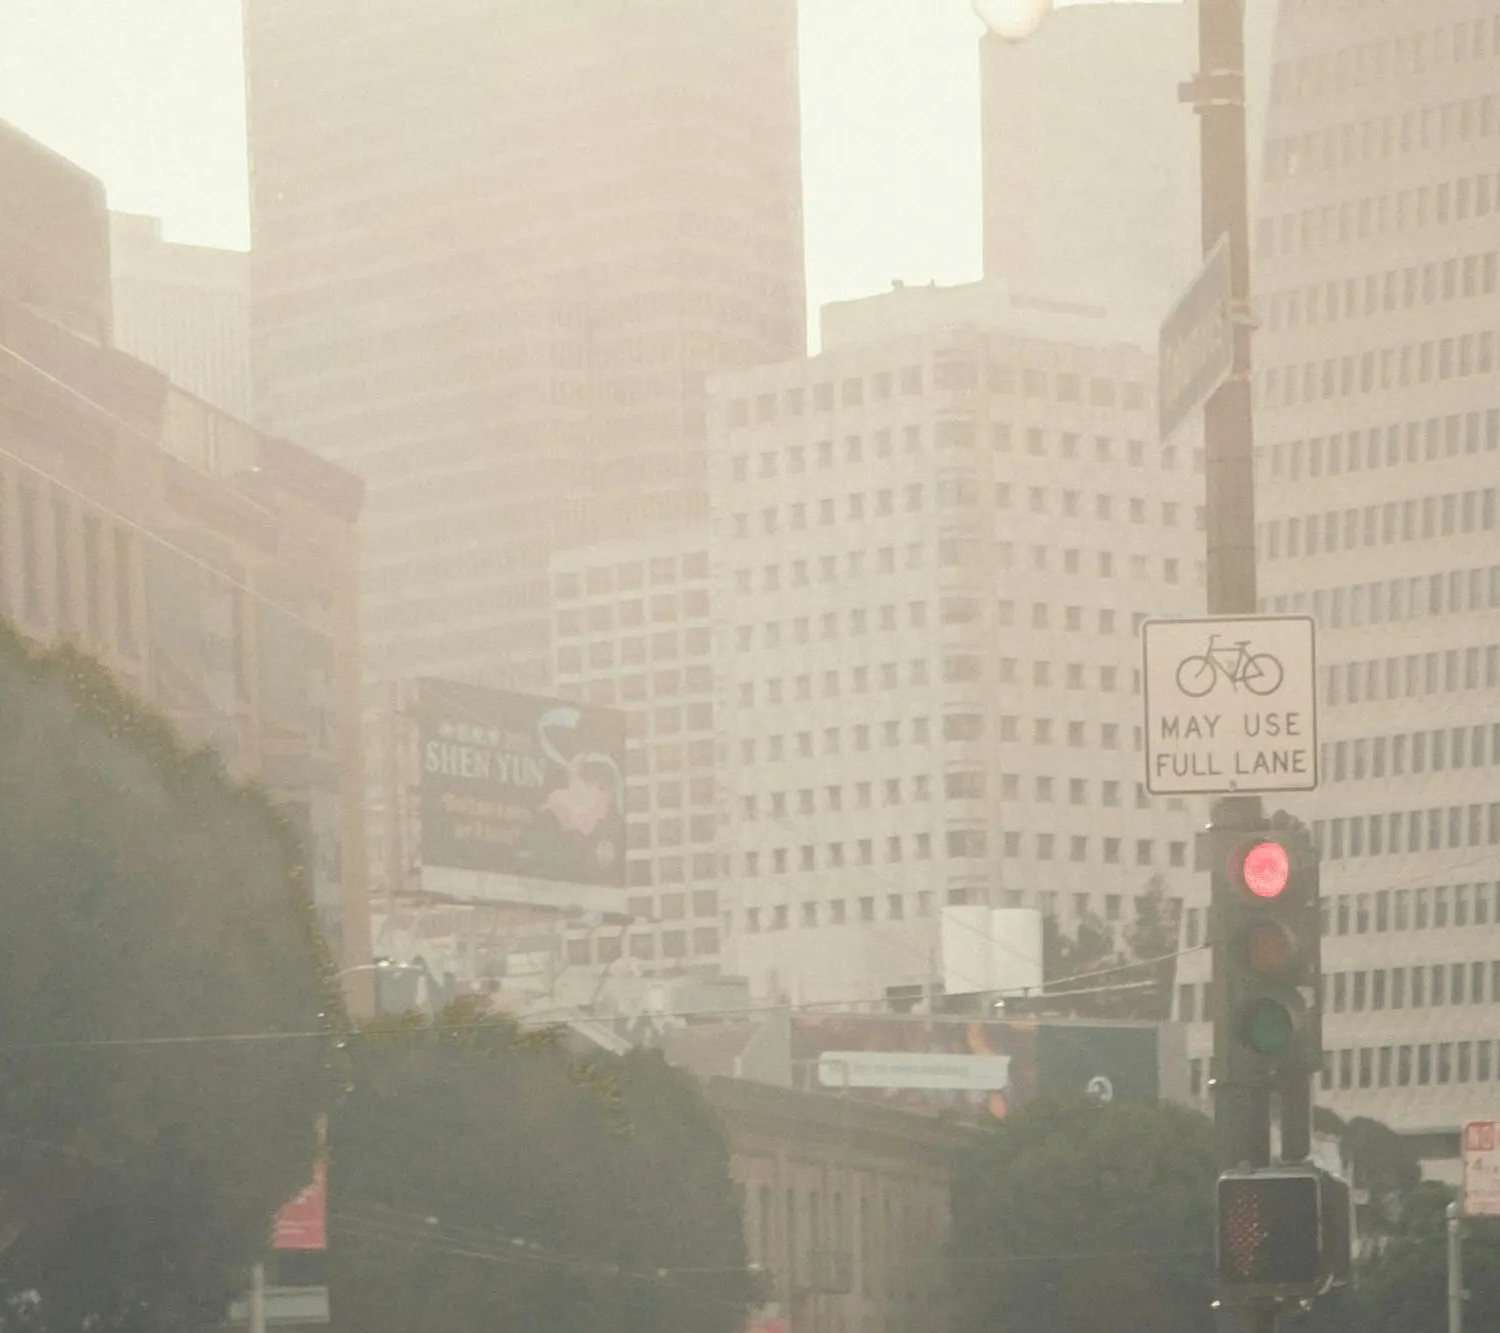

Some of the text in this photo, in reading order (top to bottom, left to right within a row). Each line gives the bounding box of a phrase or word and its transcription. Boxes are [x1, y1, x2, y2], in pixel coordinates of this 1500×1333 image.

[1161, 712, 1301, 739] MAY USE
[426, 740, 546, 787] SHEN YUN
[1156, 750, 1307, 777] FULL LANE
